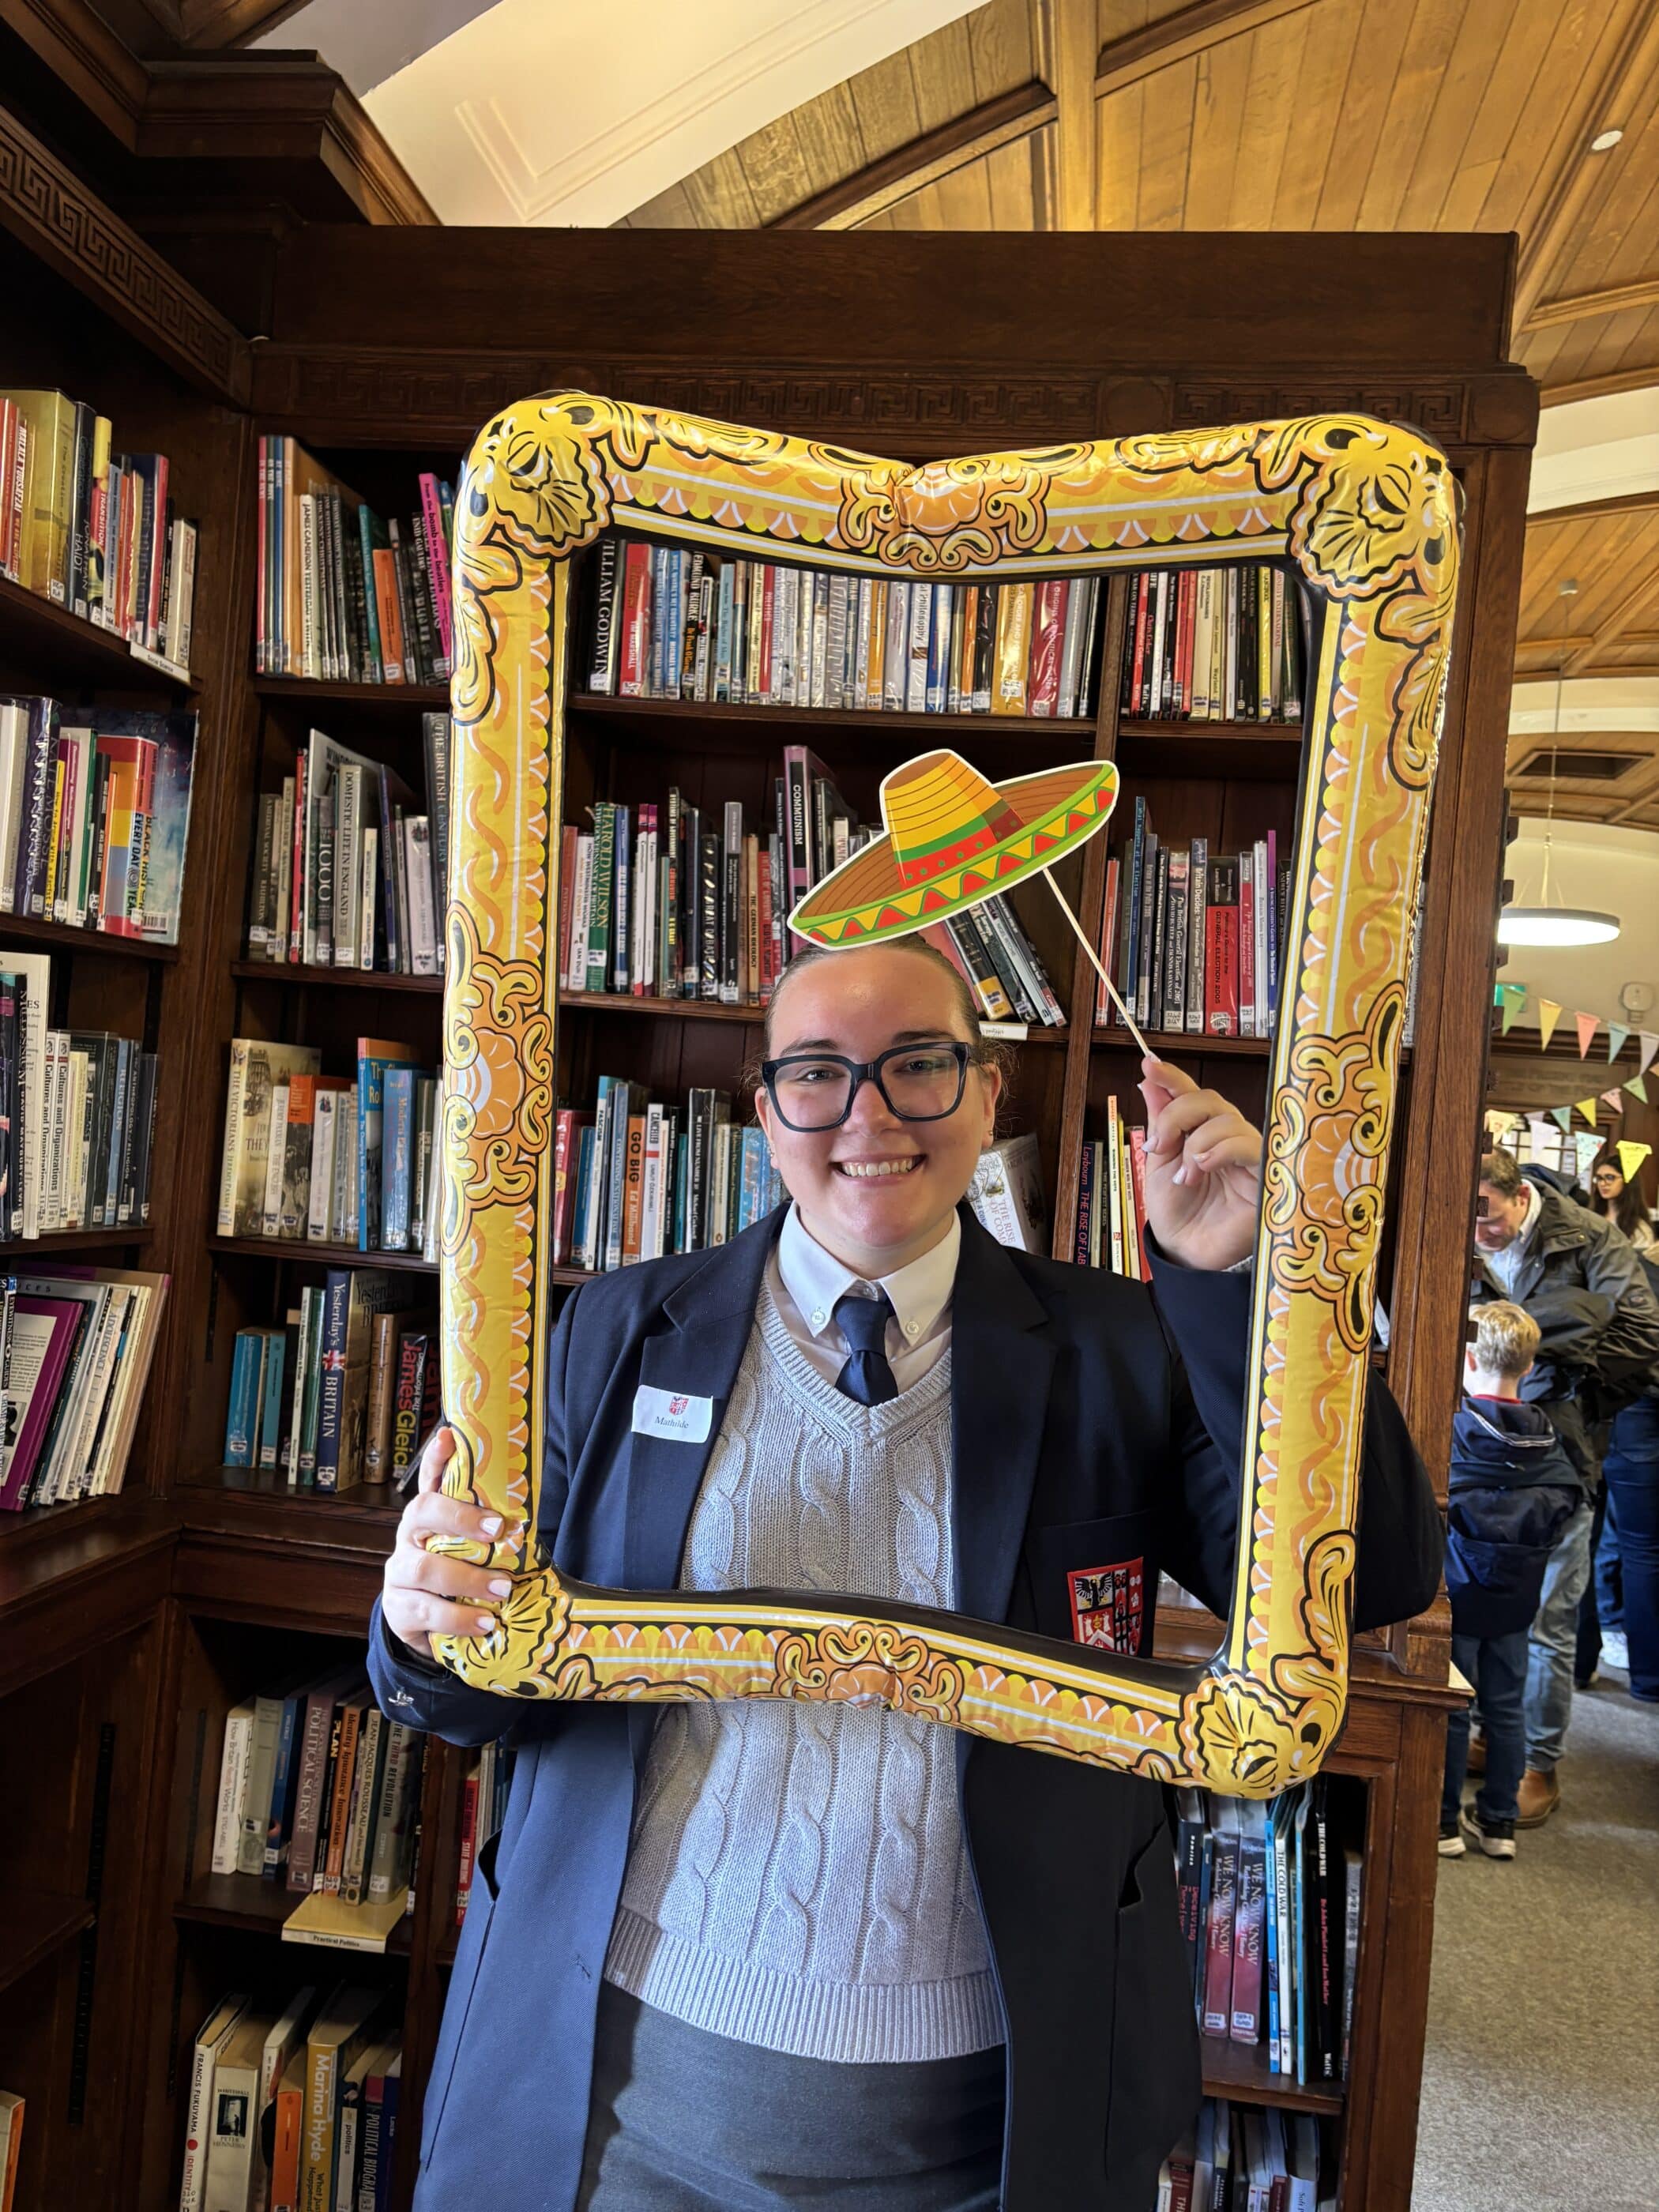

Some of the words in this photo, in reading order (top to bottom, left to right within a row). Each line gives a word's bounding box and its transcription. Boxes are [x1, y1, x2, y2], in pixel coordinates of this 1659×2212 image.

[17, 426, 27, 462] MALALA
[97, 492, 107, 546] TRANSITION
[73, 533, 83, 574] HAIDT
[427, 513, 439, 538] bomb
[434, 559, 446, 593] beatles
[916, 594, 927, 641] Philosophy
[595, 607, 612, 675] GODWIN
[627, 634, 638, 669] MARSHALL
[1141, 683, 1150, 704] Watts
[434, 752, 446, 802] BRITISH
[342, 770, 354, 826] DOMESTIC
[792, 784, 803, 845] COMMUNISM
[134, 813, 144, 845] EVERY
[341, 826, 352, 850] LIFE
[435, 804, 446, 863] CENTURY
[600, 807, 614, 868] HAROLD
[130, 847, 141, 867] DAY
[340, 852, 352, 865] IN
[339, 867, 352, 916] ENGLAND
[596, 871, 610, 928] WILSON
[58, 1065, 67, 1100] Cultures
[115, 1068, 126, 1130] RELIGION
[55, 1103, 65, 1125] and
[649, 1112, 660, 1144] CANCELLED
[48, 1127, 62, 1191] Organizations
[630, 1131, 641, 1153] GO
[629, 1159, 641, 1183] BIG
[1081, 1146, 1092, 1185] Laybourn
[629, 1190, 638, 1201] Ed
[1080, 1192, 1089, 1209] THE
[627, 1202, 637, 1246] Miliband
[1003, 1223, 1016, 1243] RISE
[1078, 1212, 1089, 1230] RISE
[1078, 1232, 1087, 1245] OF
[1078, 1247, 1086, 1264] LAB
[6, 1296, 15, 1344] EYEWITNESS
[330, 1283, 346, 1346] Yesterday's
[96, 1312, 117, 1372] ADOLESCENCE
[2, 1358, 11, 1389] GUIDES
[398, 1341, 422, 1410] James
[322, 1376, 338, 1438] BRITAIN
[393, 1410, 416, 1470] Gleic
[229, 1721, 239, 1740] How
[303, 1706, 322, 1775] POLITICAL
[329, 1720, 342, 1758] PLAN
[368, 1719, 379, 1739] JEAN
[364, 1740, 376, 1780] JACQUES
[389, 1740, 400, 1765] THIRD
[296, 1778, 313, 1833] SCIENCE
[359, 1781, 371, 1827] ROUSSEAU
[382, 1766, 398, 1818] REVOLUTION
[332, 1799, 346, 1845] Innovation
[1222, 1854, 1234, 1875] WE
[1251, 1862, 1262, 1884] WE
[1277, 1851, 1285, 1865] THE
[1220, 1877, 1232, 1911] NOW
[1240, 1865, 1251, 1901] Rethinking
[1277, 1866, 1286, 1895] COLD
[1187, 1886, 1199, 1941] Deceiving
[1249, 1886, 1261, 1920] NOW
[1277, 1897, 1287, 1917] WAR
[311, 1936, 343, 1945] Practical
[1218, 1915, 1231, 1958] KNOW
[1236, 1933, 1247, 1958] History
[1247, 1923, 1259, 1966] KNOW
[194, 2053, 205, 2087] FRANCIS
[311, 2053, 329, 2116] Marina
[190, 2090, 201, 2133] FUKUYAMA
[310, 2119, 325, 2161] Hyde
[344, 2124, 353, 2154] politics
[364, 2113, 380, 2157] POLITICAL
[184, 2155, 194, 2191] IDENTITY
[362, 2158, 376, 2193] BIOGRA
